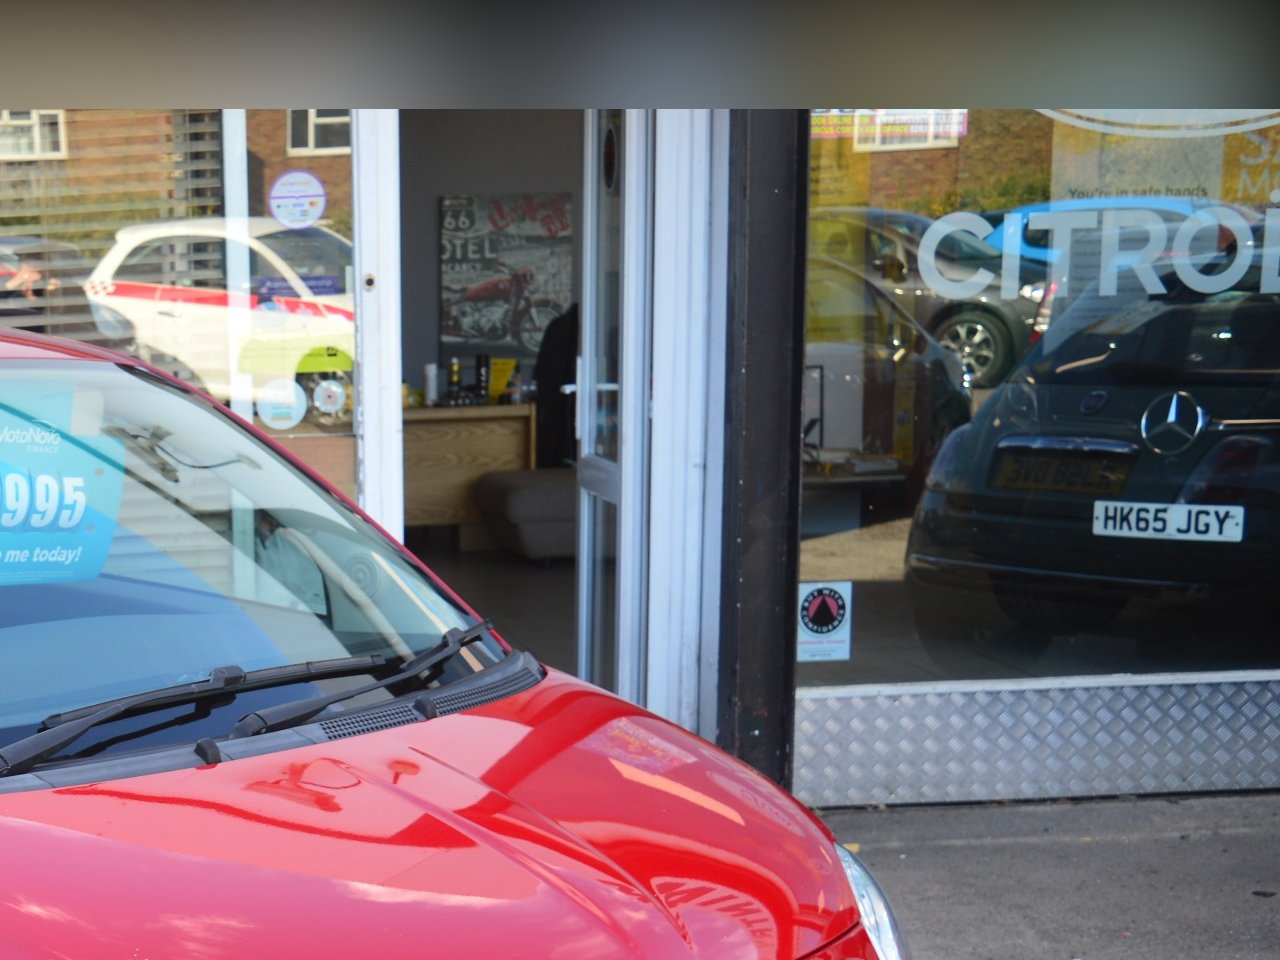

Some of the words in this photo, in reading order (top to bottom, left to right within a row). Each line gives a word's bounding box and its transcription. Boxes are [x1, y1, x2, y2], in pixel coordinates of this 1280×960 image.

[1165, 185, 1208, 198] hands
[443, 211, 470, 229] 66
[1103, 506, 1168, 533] HK65
[1176, 509, 1231, 535] JGY
[4, 549, 30, 563] me
[32, 546, 83, 565] today!
[822, 589, 843, 606] WITH
[801, 610, 844, 632] CONFIDENCE
